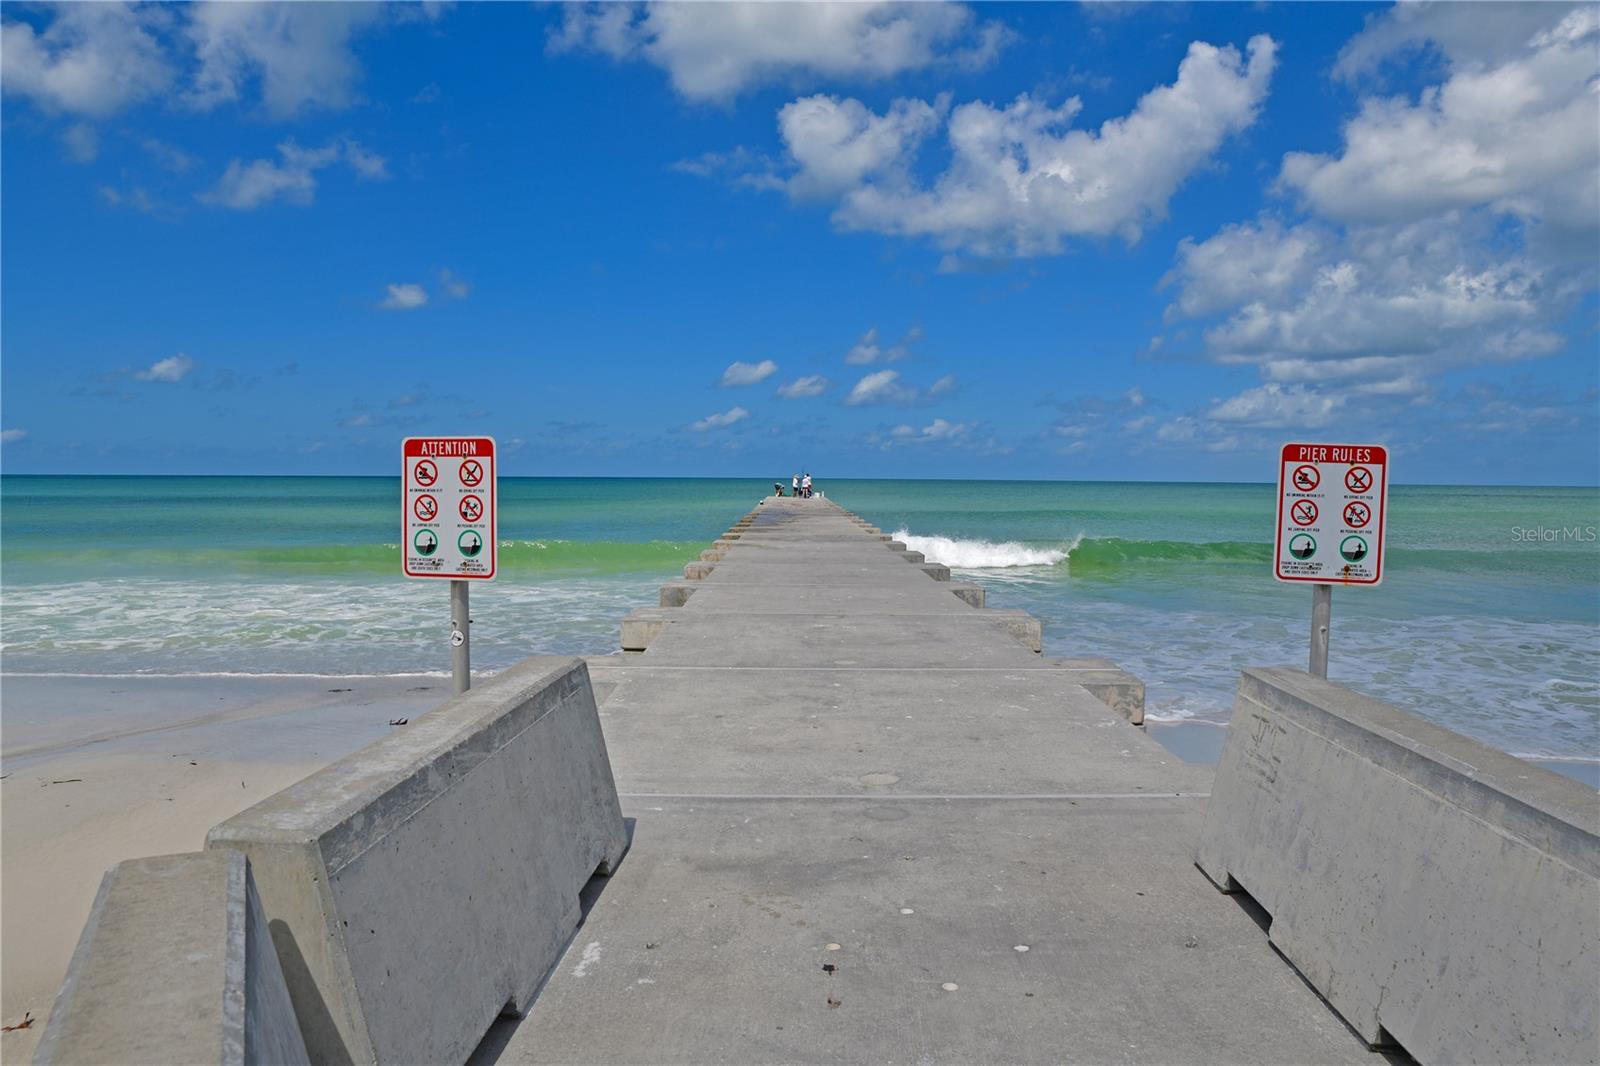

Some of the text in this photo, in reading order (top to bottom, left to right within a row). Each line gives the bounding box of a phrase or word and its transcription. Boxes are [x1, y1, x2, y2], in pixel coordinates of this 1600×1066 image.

[421, 441, 477, 455] ATTENTION
[1299, 447, 1371, 462] PIER RULES
